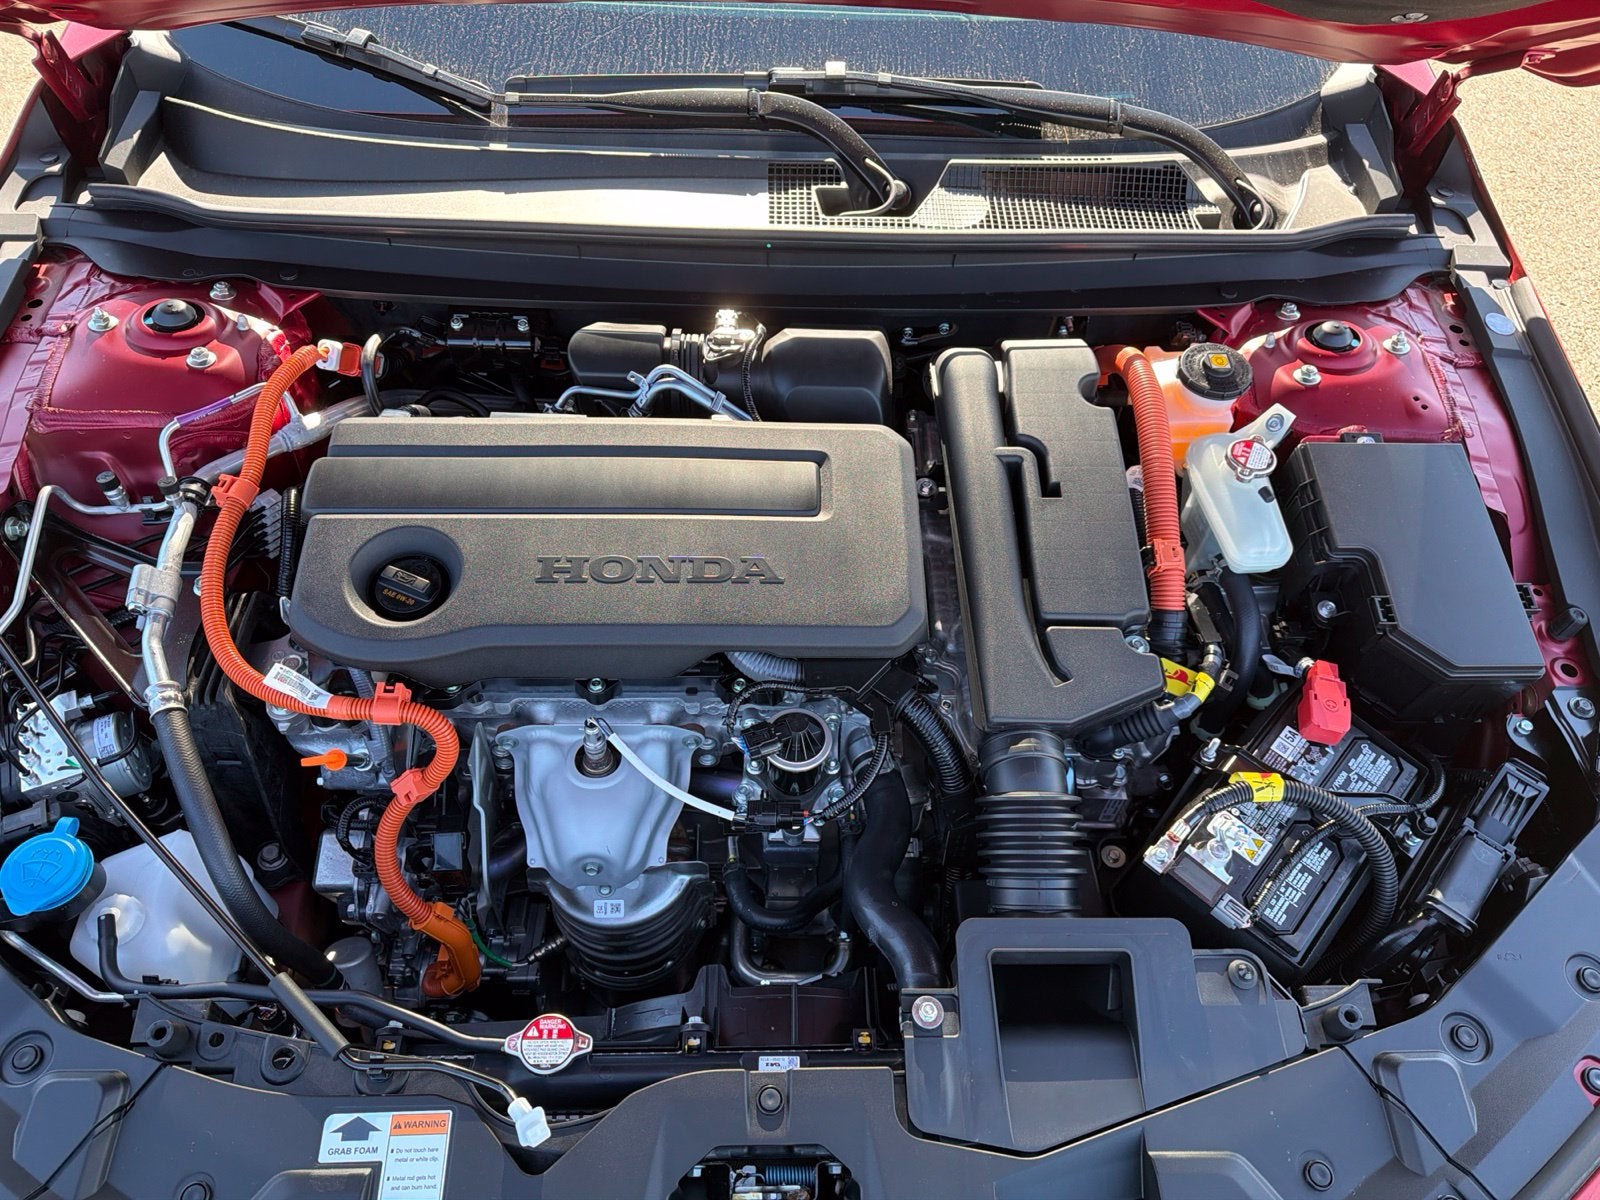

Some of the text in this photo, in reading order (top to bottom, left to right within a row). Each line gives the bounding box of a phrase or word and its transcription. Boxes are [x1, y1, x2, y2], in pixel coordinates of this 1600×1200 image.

[534, 554, 786, 585] HONDA
[382, 588, 397, 598] SAE
[1284, 730, 1299, 743] 5A
[404, 1119, 447, 1129] WARNING
[328, 1146, 379, 1156] GRAB FOAM
